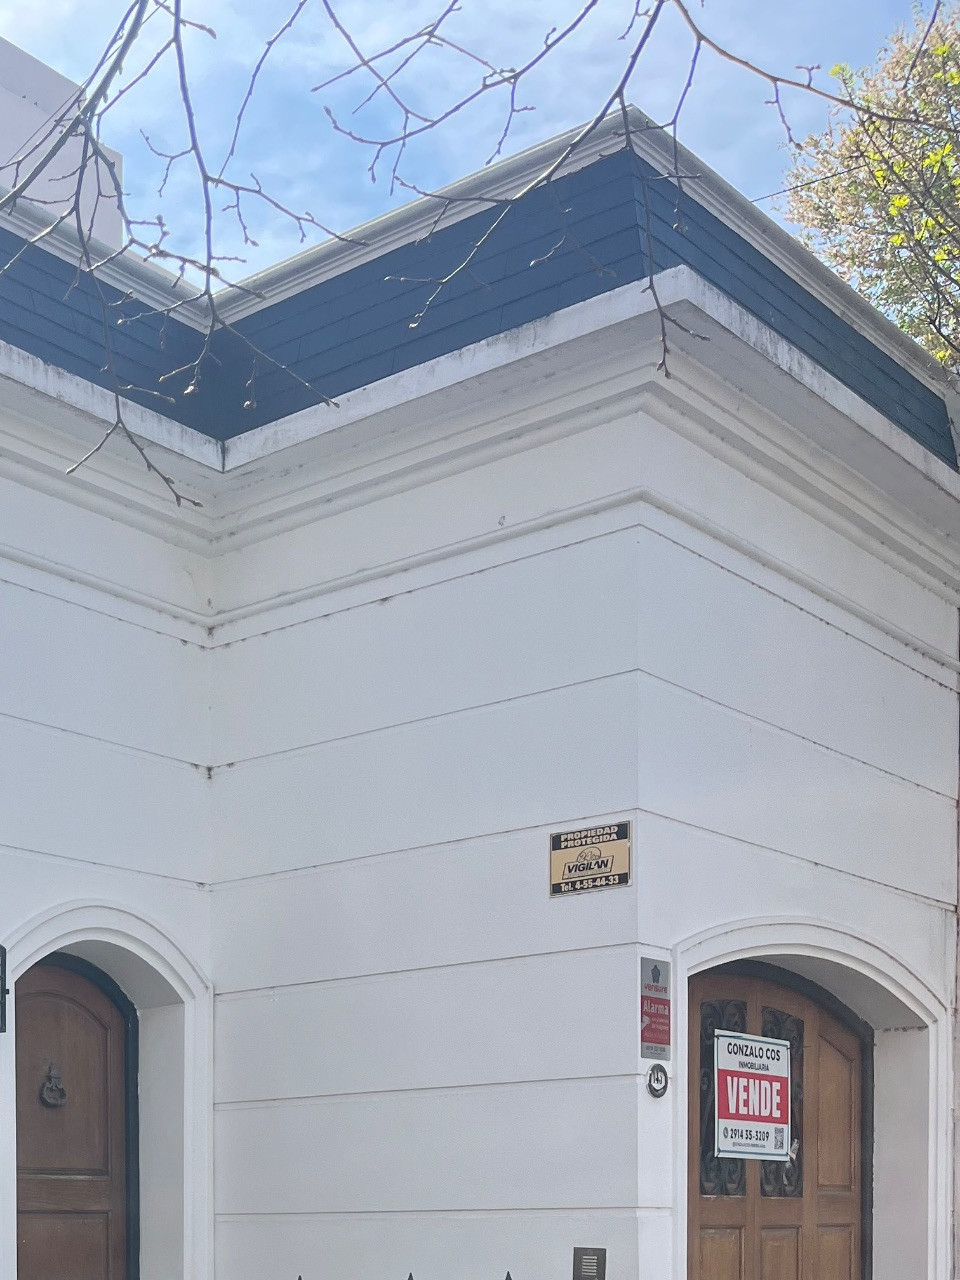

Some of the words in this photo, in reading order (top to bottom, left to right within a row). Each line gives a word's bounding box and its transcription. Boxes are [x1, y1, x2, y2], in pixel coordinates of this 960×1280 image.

[561, 826, 618, 841] PROPIEDAD
[561, 833, 618, 848] PROTEGIDA
[567, 859, 609, 873] VIGILAN
[575, 875, 619, 890] 4-55-44-33
[643, 999, 669, 1015] Alarma
[727, 1042, 764, 1060] GONZALO
[765, 1049, 781, 1061] COS
[738, 1061, 769, 1072] INMOBILIARIA
[726, 1075, 781, 1118] VENDE
[730, 1128, 744, 1139] 2914
